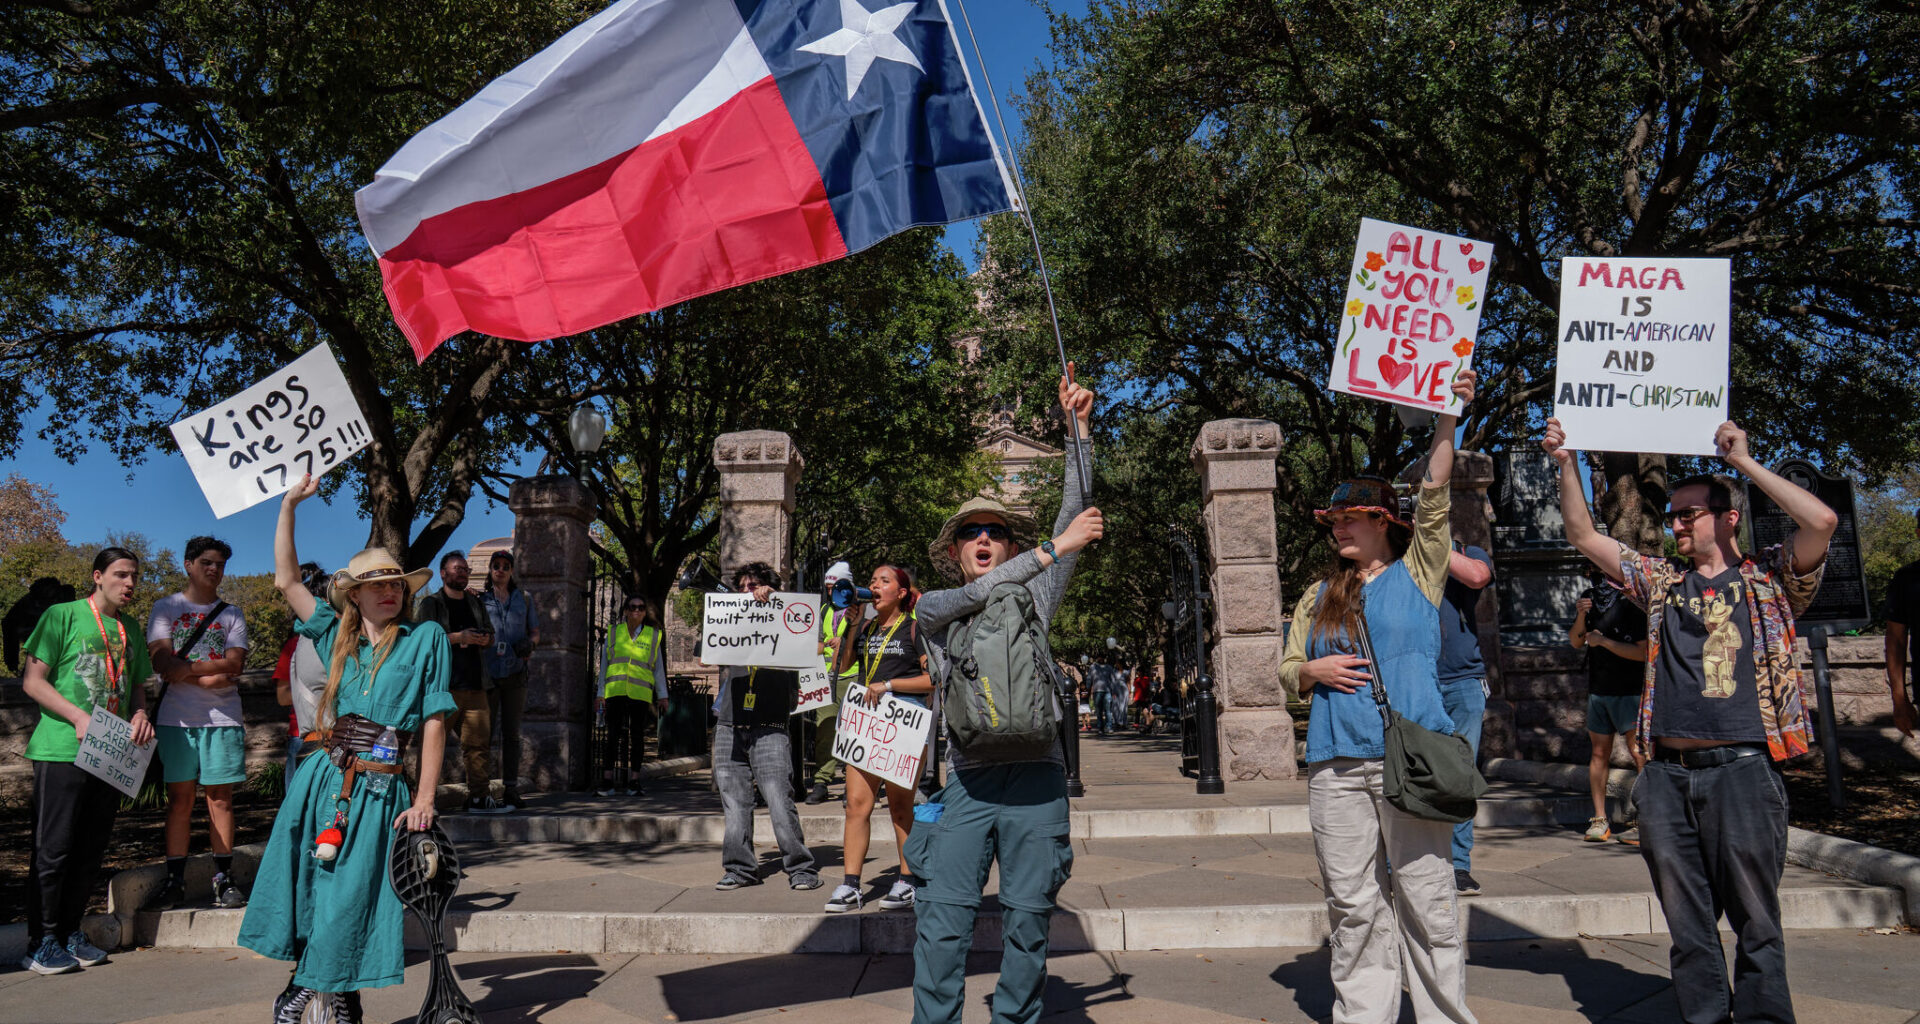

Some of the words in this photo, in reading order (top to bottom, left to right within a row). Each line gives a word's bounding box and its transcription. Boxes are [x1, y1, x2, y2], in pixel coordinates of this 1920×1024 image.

[1386, 231, 1448, 274] ALL
[1381, 270, 1454, 308] YOU
[1577, 262, 1685, 291] MAGA
[1620, 296, 1652, 317] IS
[1364, 303, 1454, 342] NEED
[1564, 320, 1715, 342] ANTI-AMERICAN
[1388, 337, 1418, 360] IS
[1603, 349, 1655, 372] AND
[1557, 382, 1724, 411] ANTI-CHRISTIAN
[191, 375, 309, 457] Kings
[229, 435, 283, 470] are
[707, 612, 743, 625] built
[747, 611, 775, 624] this
[708, 595, 784, 613] Immigrants
[840, 704, 898, 744] HATRED
[885, 700, 923, 730] Spell
[95, 711, 150, 750] STUDES
[83, 751, 102, 769] THE
[84, 733, 126, 763] PROPERTY
[125, 757, 139, 770] OF
